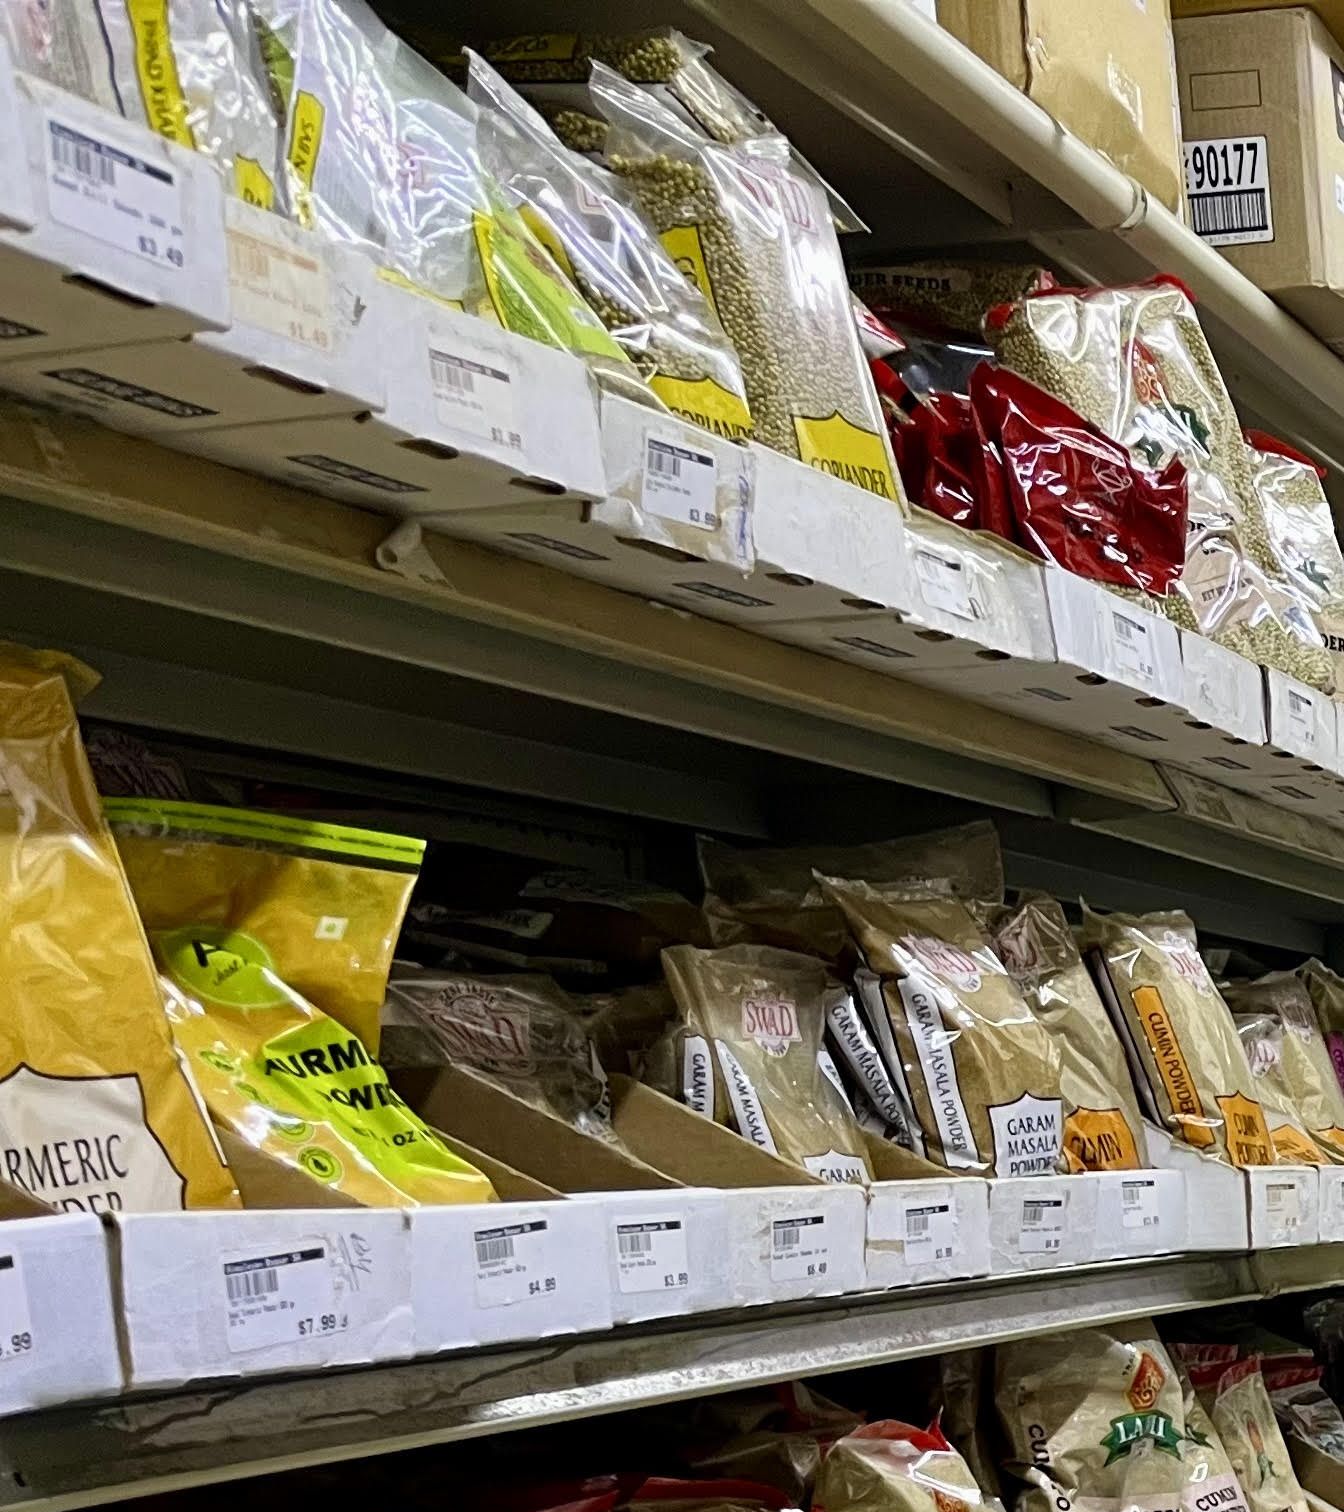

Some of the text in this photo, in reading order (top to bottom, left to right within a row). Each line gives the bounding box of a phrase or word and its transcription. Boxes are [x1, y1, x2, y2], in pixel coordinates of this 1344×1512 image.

[1148, 1011, 1174, 1054] CUMIN
[1008, 1114, 1056, 1135] GARAM
[1008, 1136, 1058, 1155] MASALA
[1114, 1415, 1167, 1445] LAI
